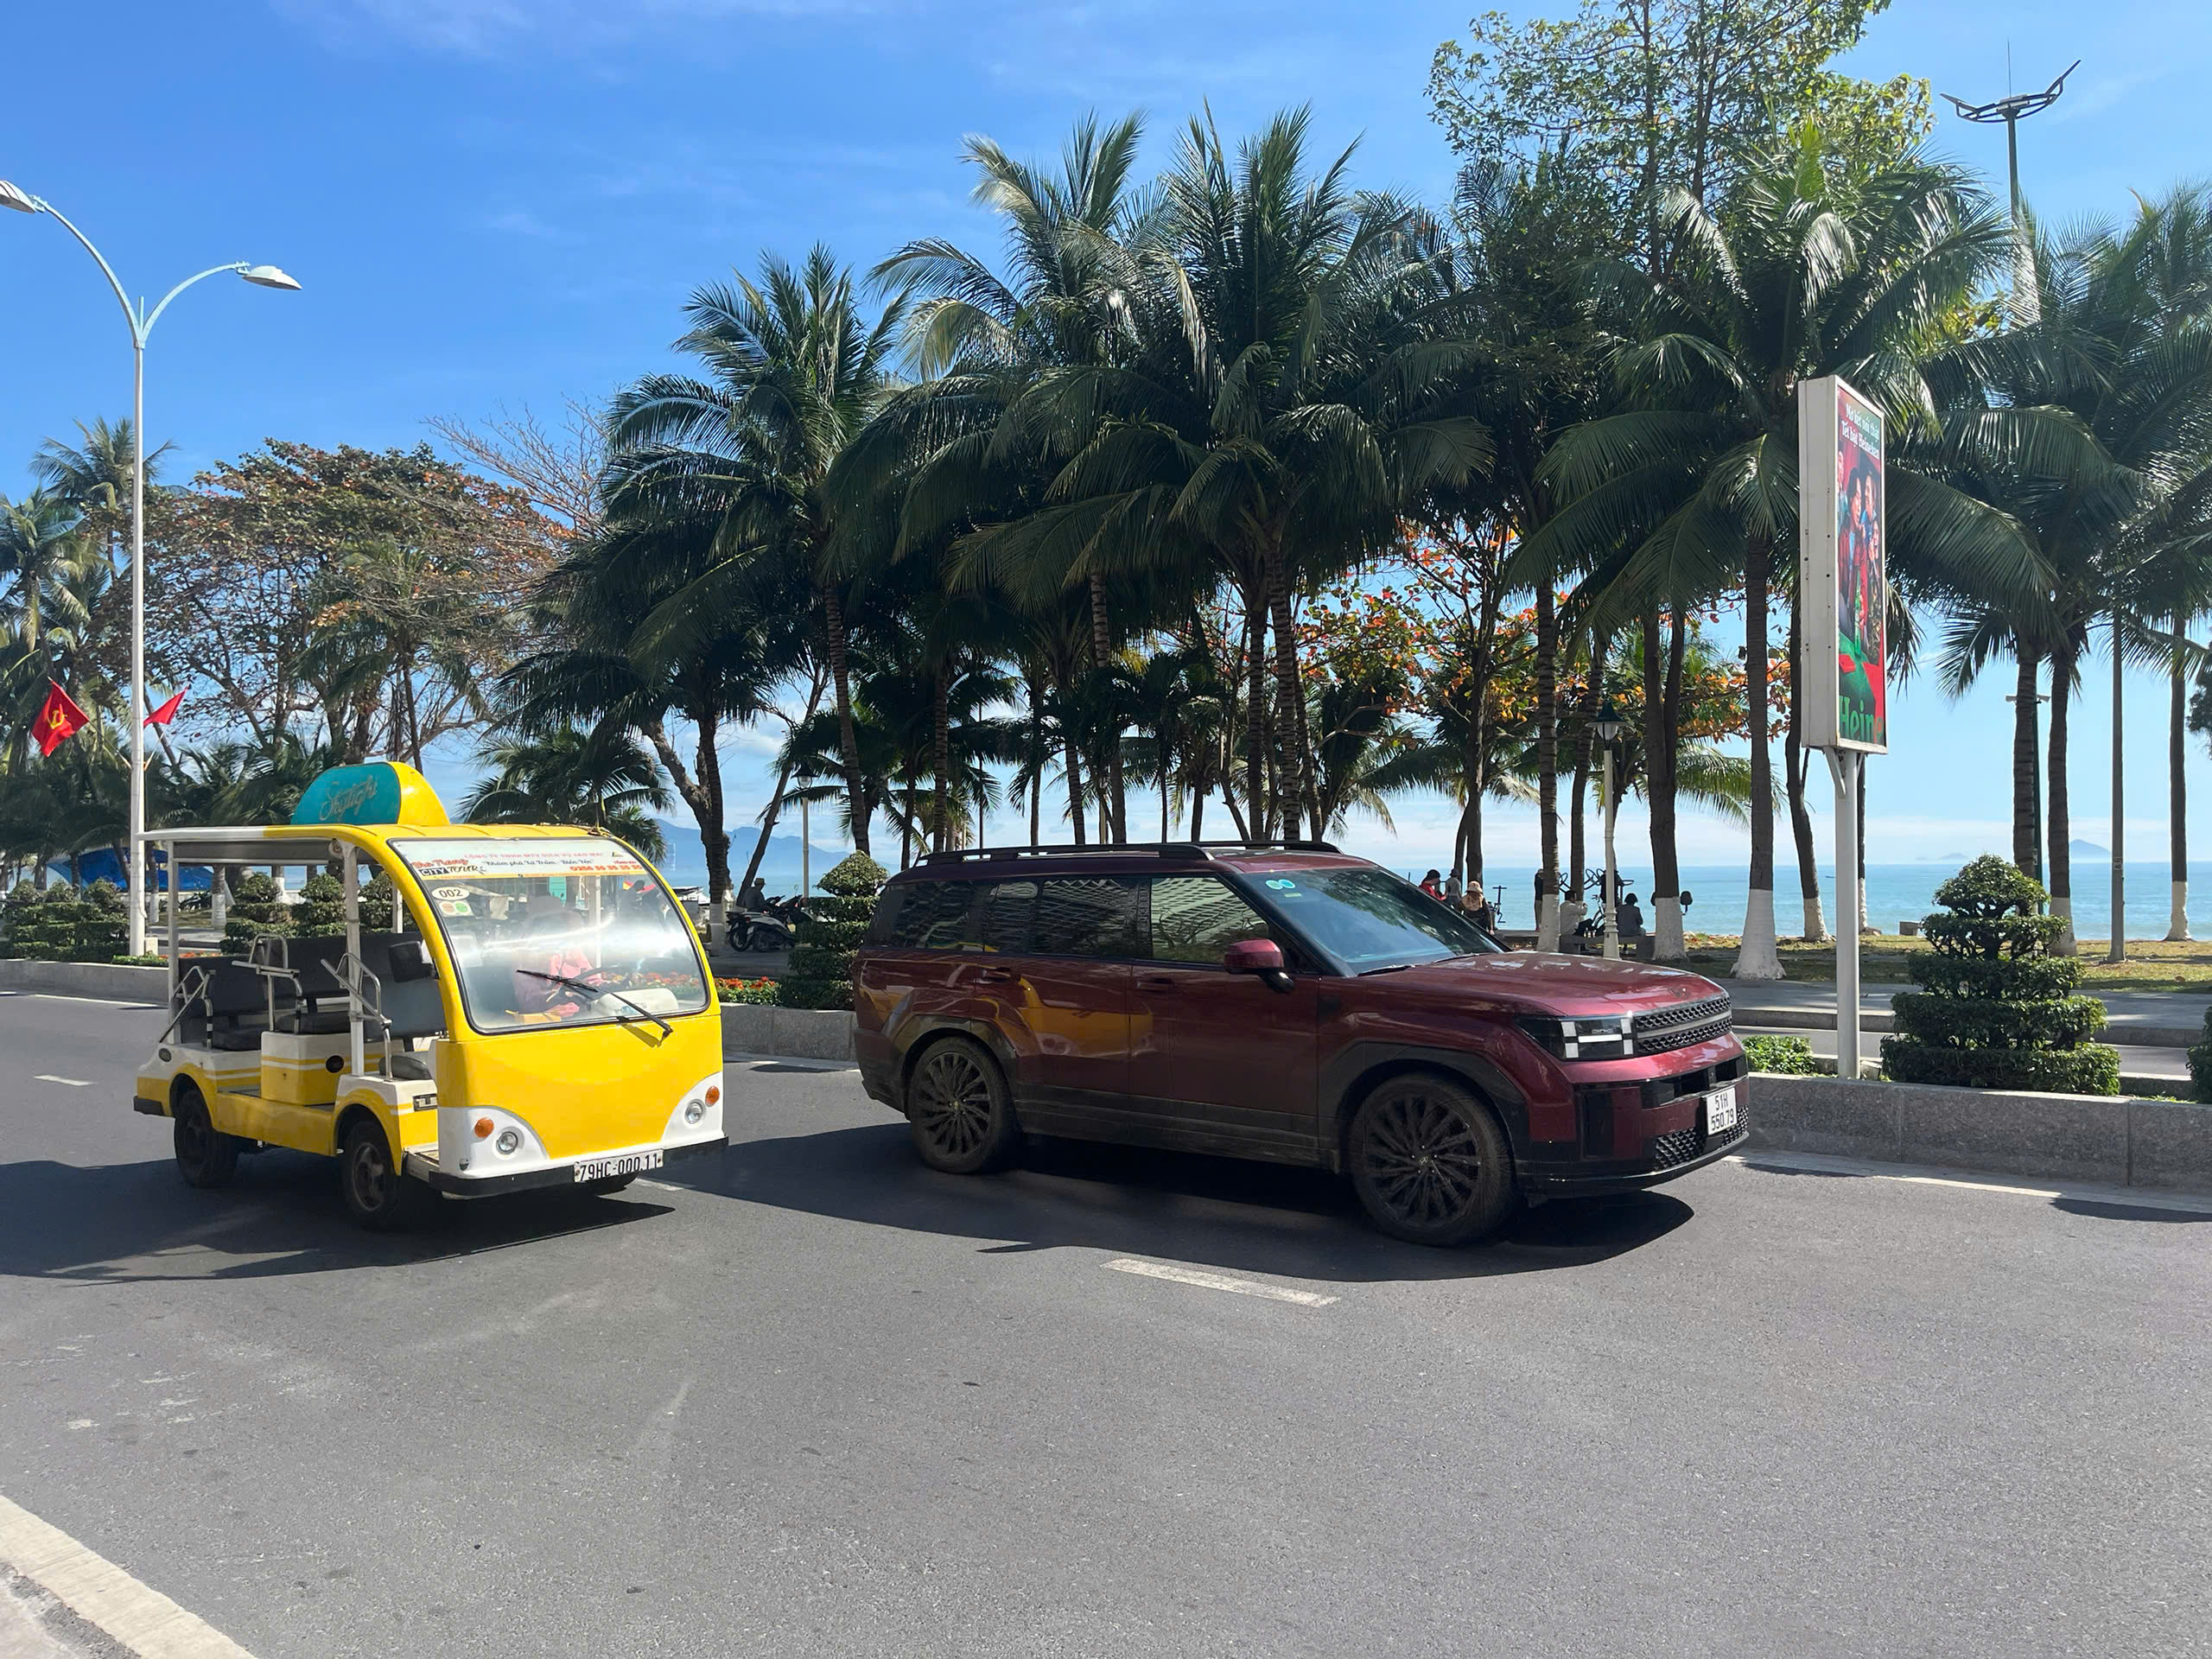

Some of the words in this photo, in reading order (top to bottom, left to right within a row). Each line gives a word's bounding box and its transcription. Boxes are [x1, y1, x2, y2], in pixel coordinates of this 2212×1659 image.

[421, 866, 448, 876] CITY
[447, 865, 482, 874] TOUR
[439, 889, 463, 898] 002
[1714, 1092, 1729, 1111] 51H
[1711, 1109, 1735, 1131] 550.79
[580, 1153, 658, 1182] 79HC-000.11
